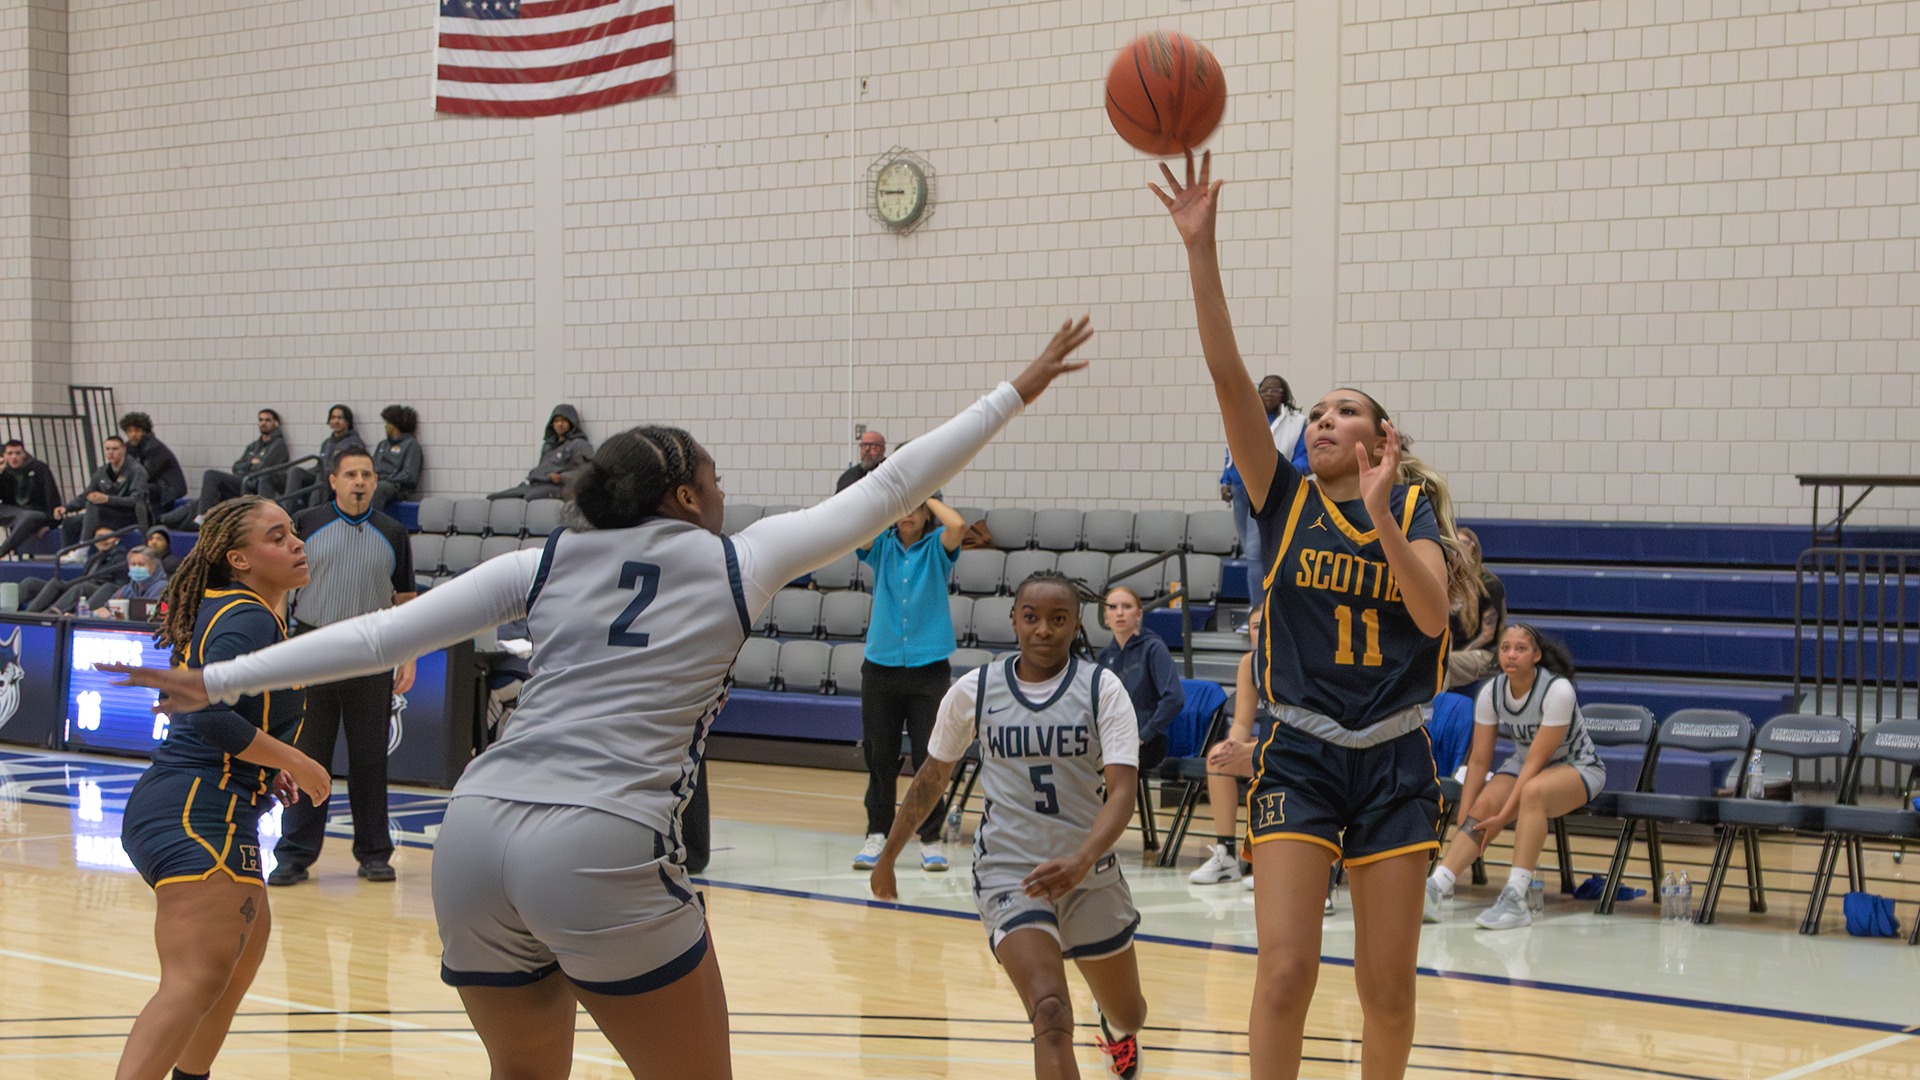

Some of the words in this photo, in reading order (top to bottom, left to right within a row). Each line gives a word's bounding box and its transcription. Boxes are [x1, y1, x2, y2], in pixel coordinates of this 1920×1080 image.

[607, 561, 661, 647] 2
[1334, 605, 1383, 666] 11
[987, 725, 1089, 758] WOLVES
[1029, 764, 1060, 815] 5
[1257, 792, 1285, 829] H
[240, 845, 261, 872] H
